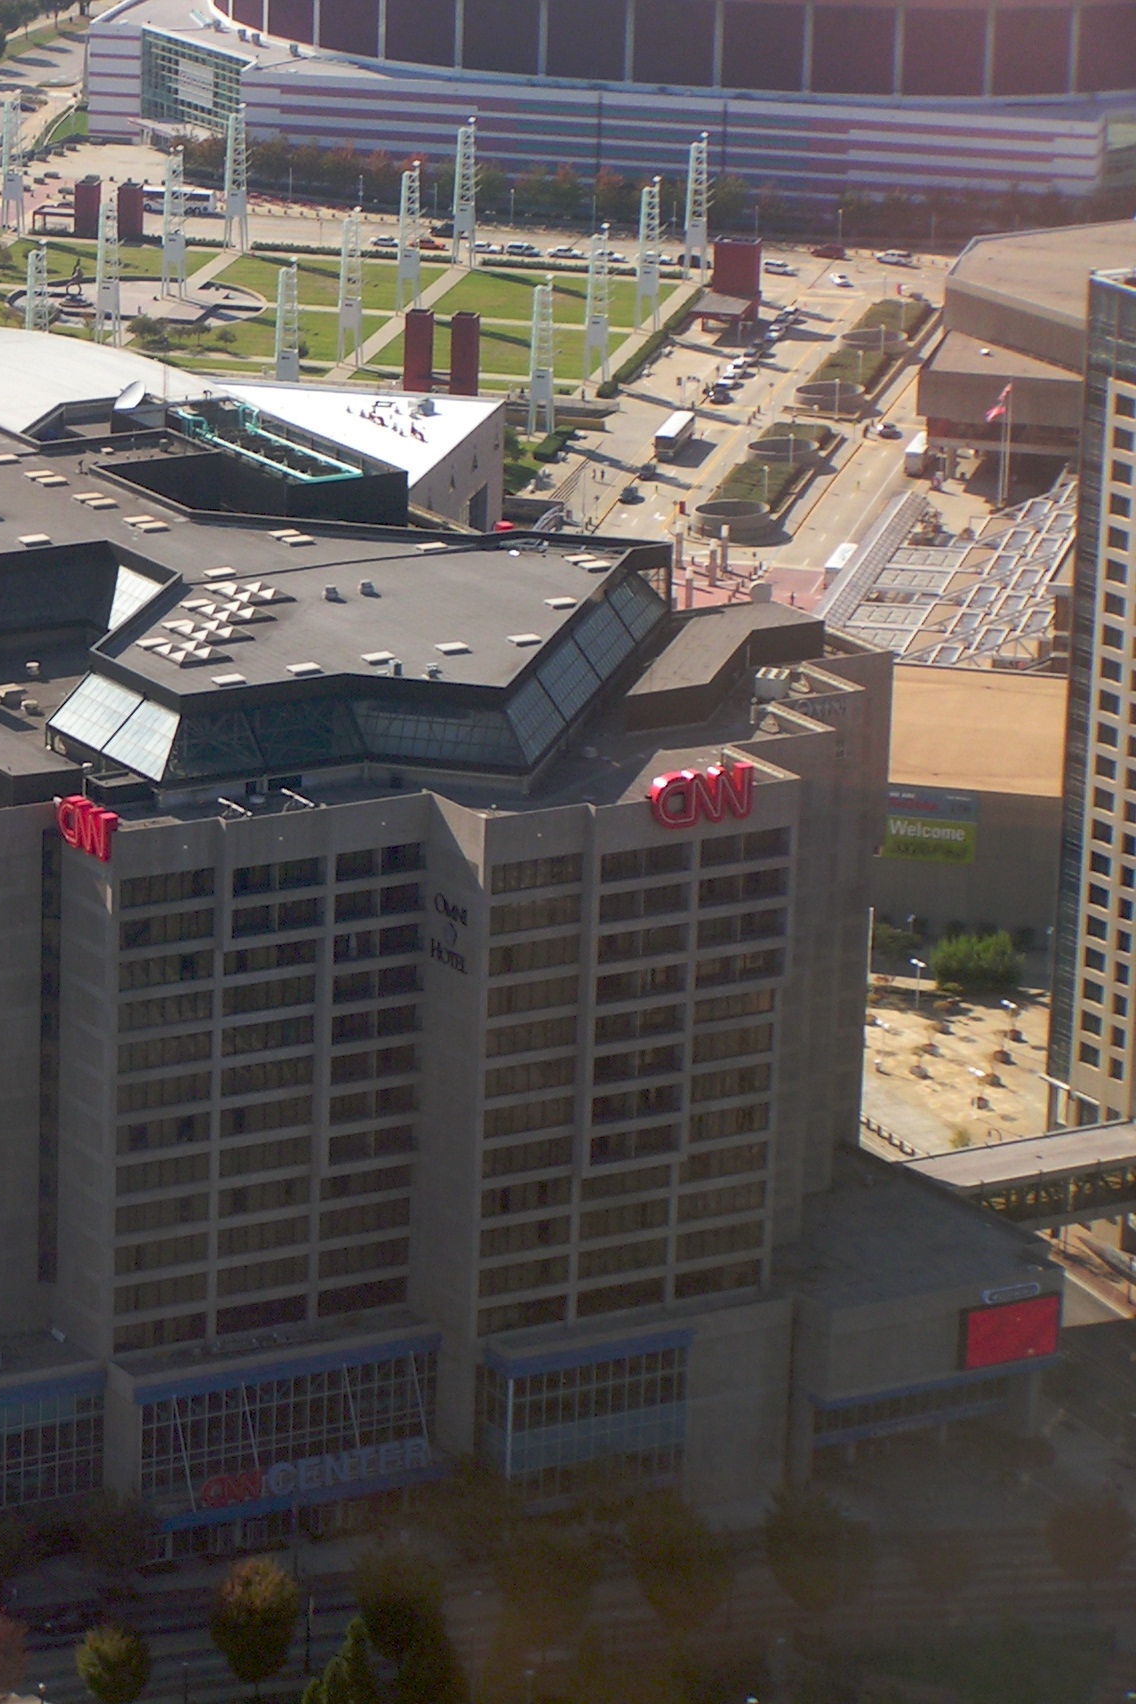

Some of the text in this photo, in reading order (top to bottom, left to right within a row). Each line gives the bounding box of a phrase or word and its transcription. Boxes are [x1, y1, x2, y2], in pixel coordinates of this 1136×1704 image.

[57, 795, 118, 862] CNN
[649, 762, 753, 829] CNN
[889, 819, 966, 841] Welcome
[201, 1436, 430, 1508] CNN CENTER
